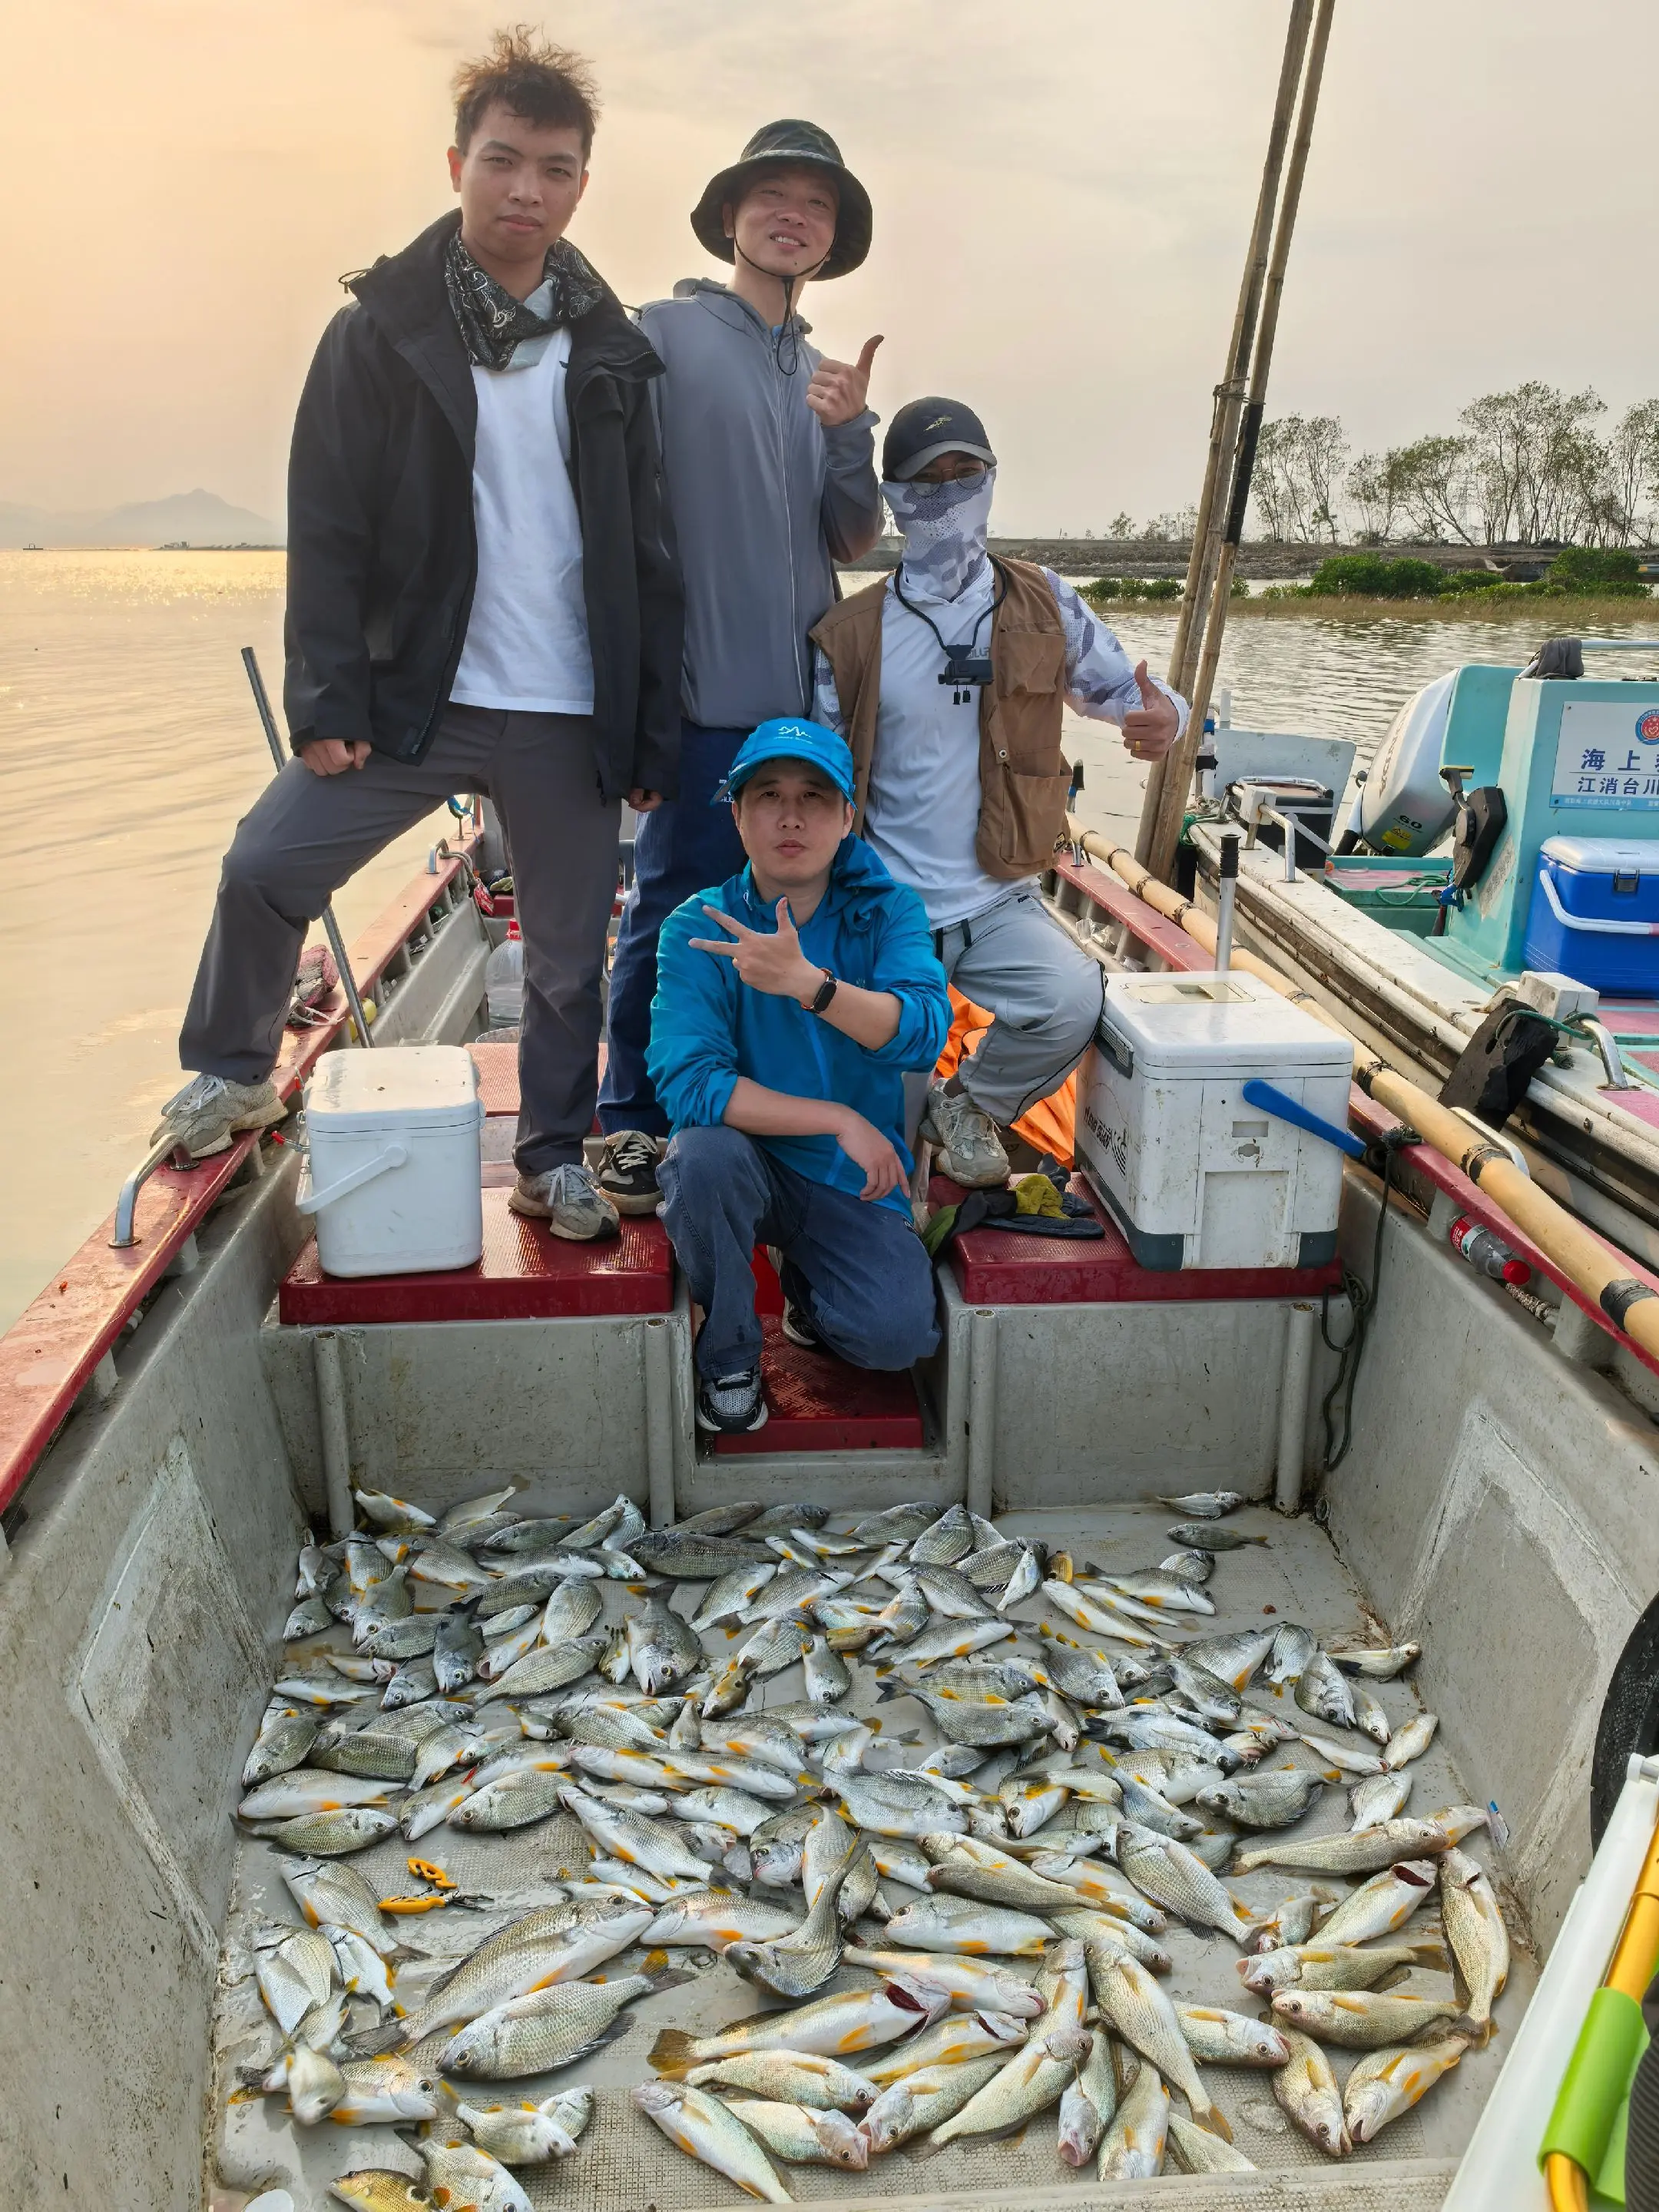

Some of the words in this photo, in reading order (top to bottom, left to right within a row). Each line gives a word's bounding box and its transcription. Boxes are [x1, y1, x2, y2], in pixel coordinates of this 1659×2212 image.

[1581, 749, 1659, 772] 海上
[1578, 777, 1659, 795] 江消台川
[1399, 815, 1422, 829] 60
